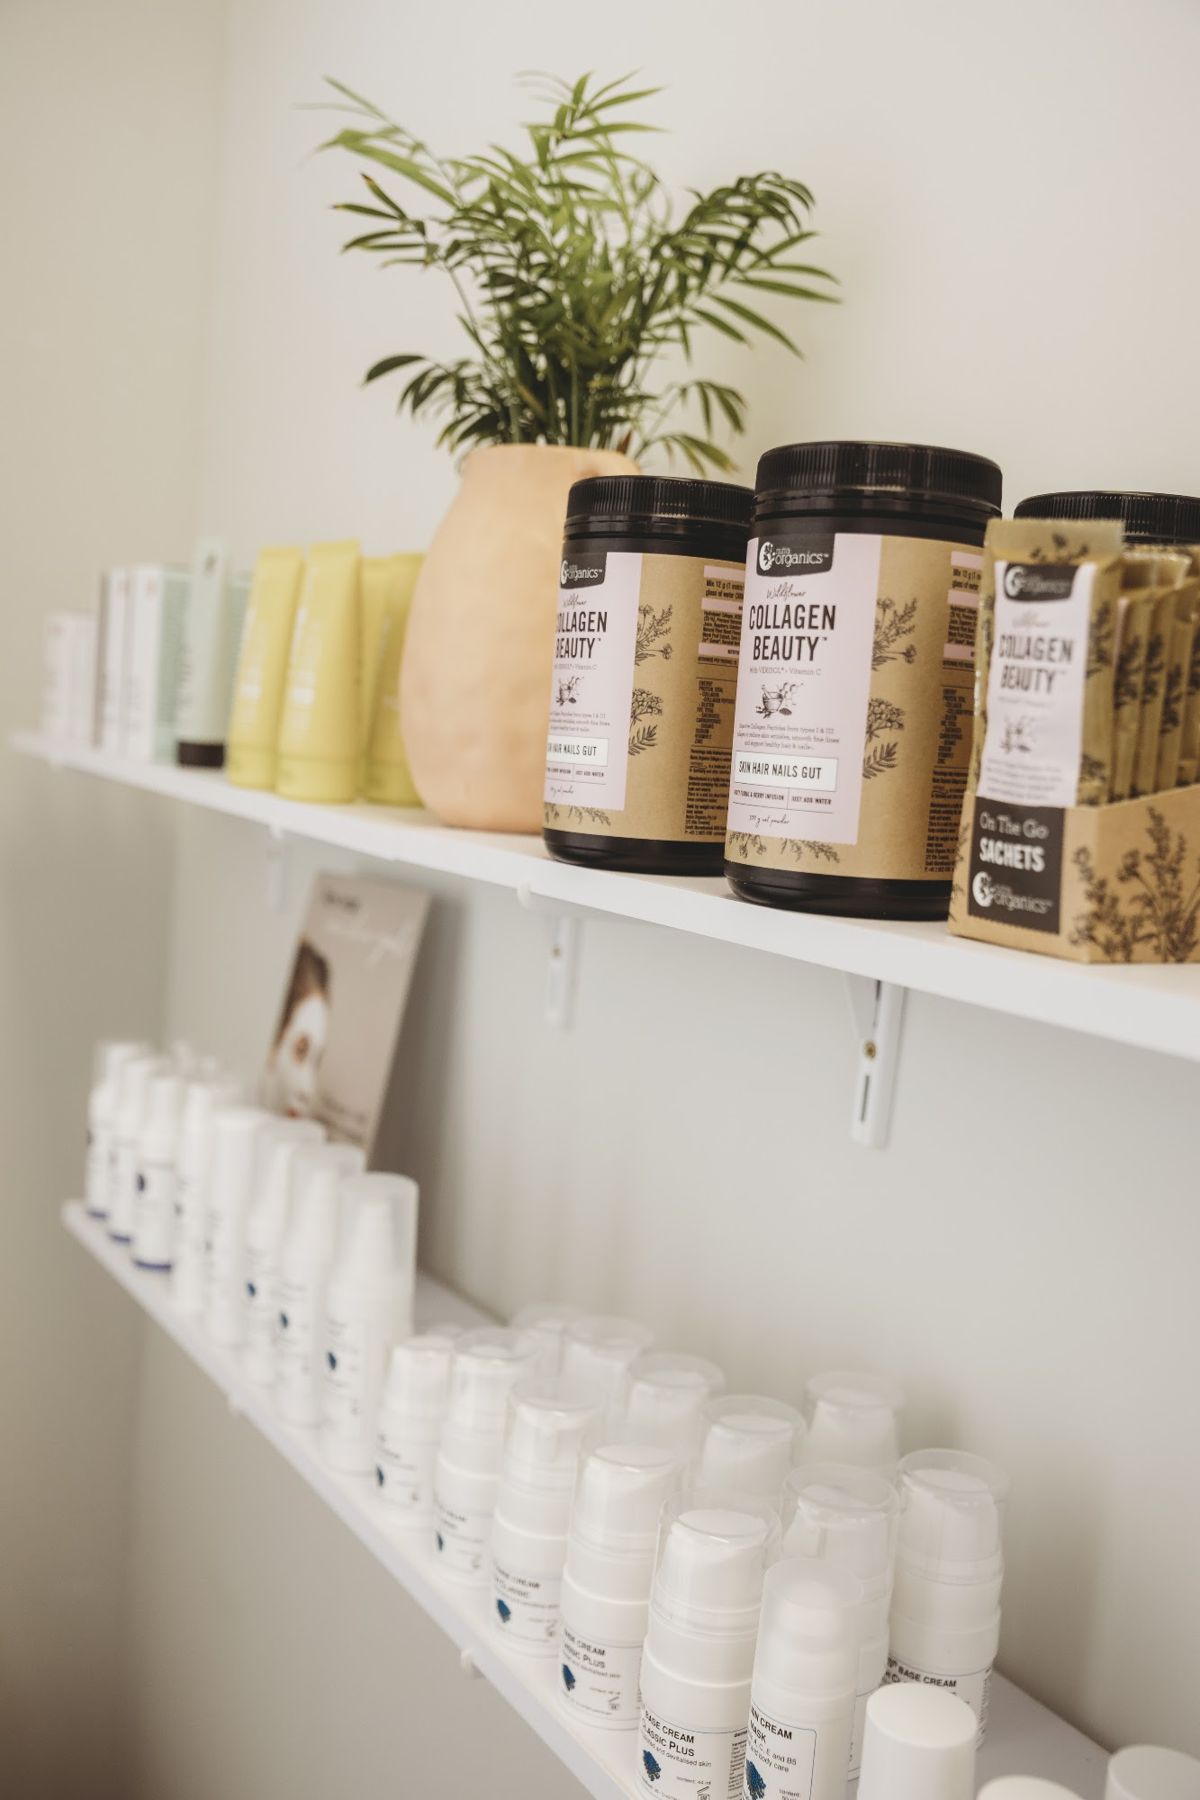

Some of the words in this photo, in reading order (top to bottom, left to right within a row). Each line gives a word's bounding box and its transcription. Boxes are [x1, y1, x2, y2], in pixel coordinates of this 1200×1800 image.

[749, 604, 837, 631] COLLAGEN
[753, 635, 819, 662] BEAUTY
[1000, 634, 1074, 665] COLLAGEN
[1001, 665, 1057, 694] BEAUTY
[582, 745, 598, 757] GUT
[752, 761, 769, 776] HAIR
[771, 763, 798, 779] NAILS
[801, 766, 822, 780] GUT
[980, 811, 997, 832] On
[997, 814, 1020, 836] The
[1022, 818, 1050, 839] Go
[979, 837, 1046, 873] SACHETS
[923, 1675, 958, 1688] CREAM
[661, 1725, 695, 1745] CREAM
[760, 1717, 793, 1741] CREAM
[668, 1740, 696, 1758] PLUS
